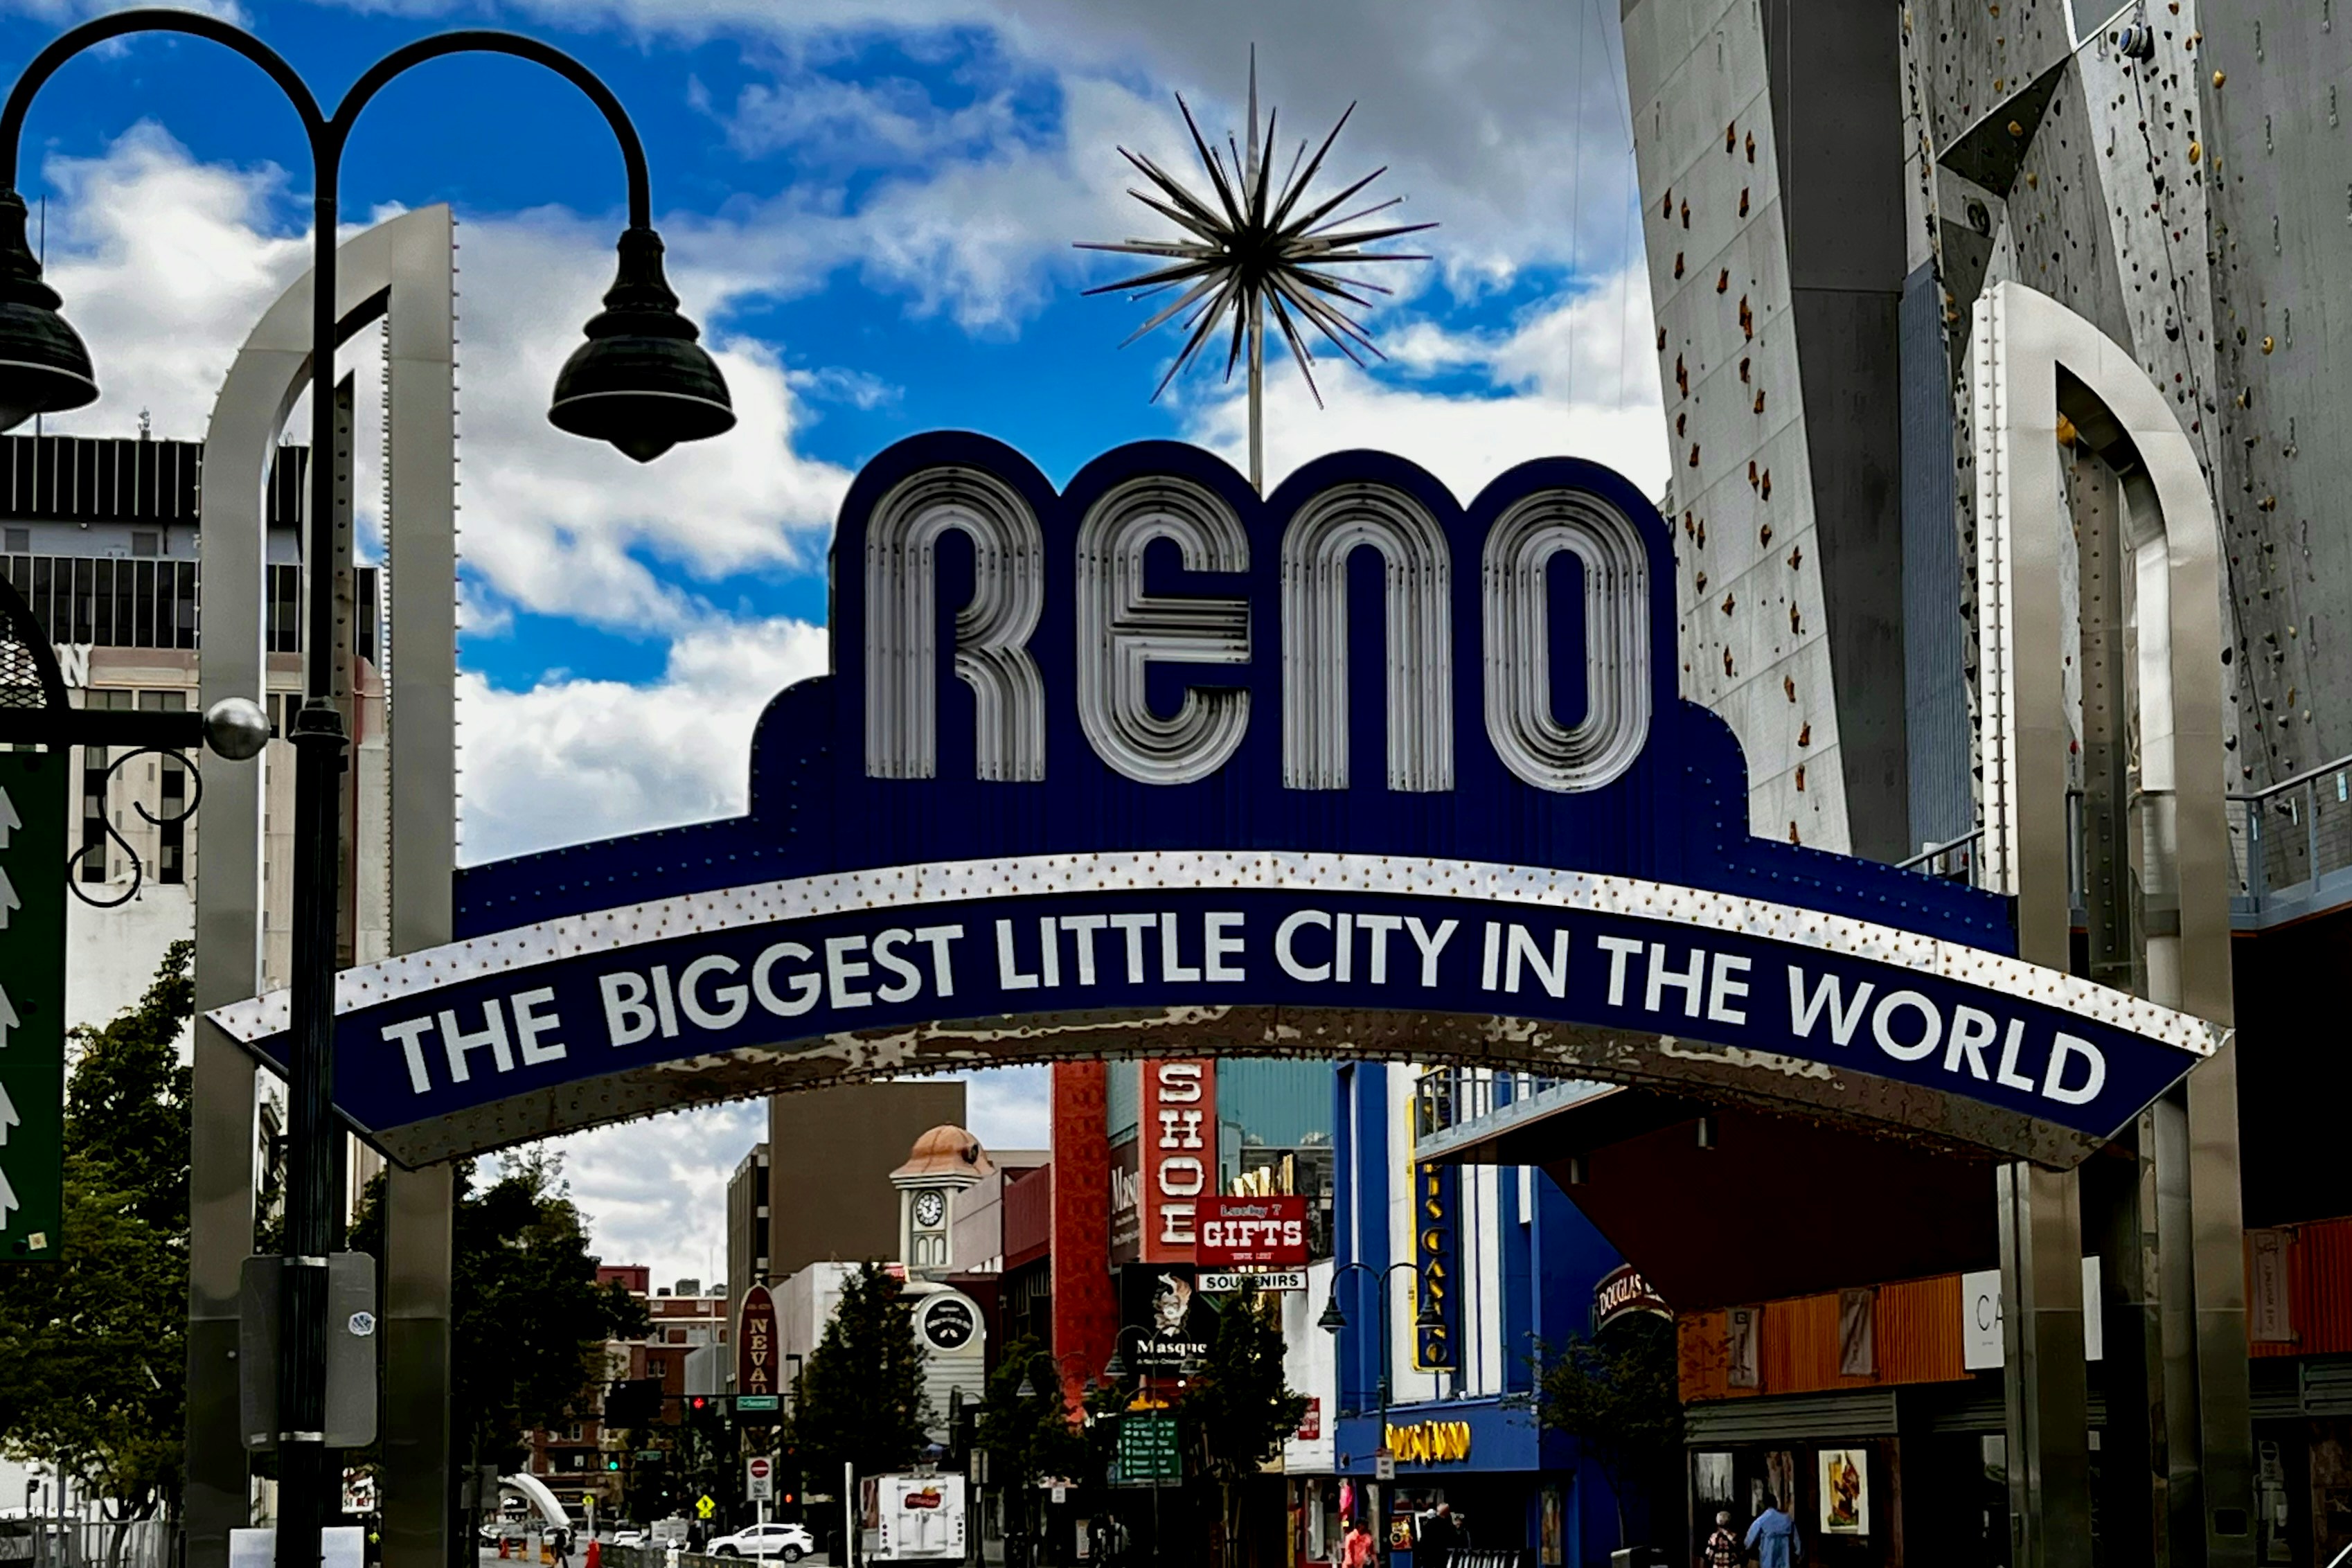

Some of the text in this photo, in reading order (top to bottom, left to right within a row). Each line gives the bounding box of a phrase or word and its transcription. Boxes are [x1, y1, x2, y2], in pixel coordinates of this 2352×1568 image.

[864, 465, 1652, 794] RENO
[381, 909, 2105, 1105] THE BIGGEST LITTLE CITY IN THE WORLD
[1158, 1063, 1204, 1242] SHOE
[1203, 1220, 1302, 1247] GIFTS
[1599, 1273, 1642, 1316] DOUGLAS
[749, 1318, 769, 1394] NEVAD
[1137, 1339, 1207, 1357] Masque
